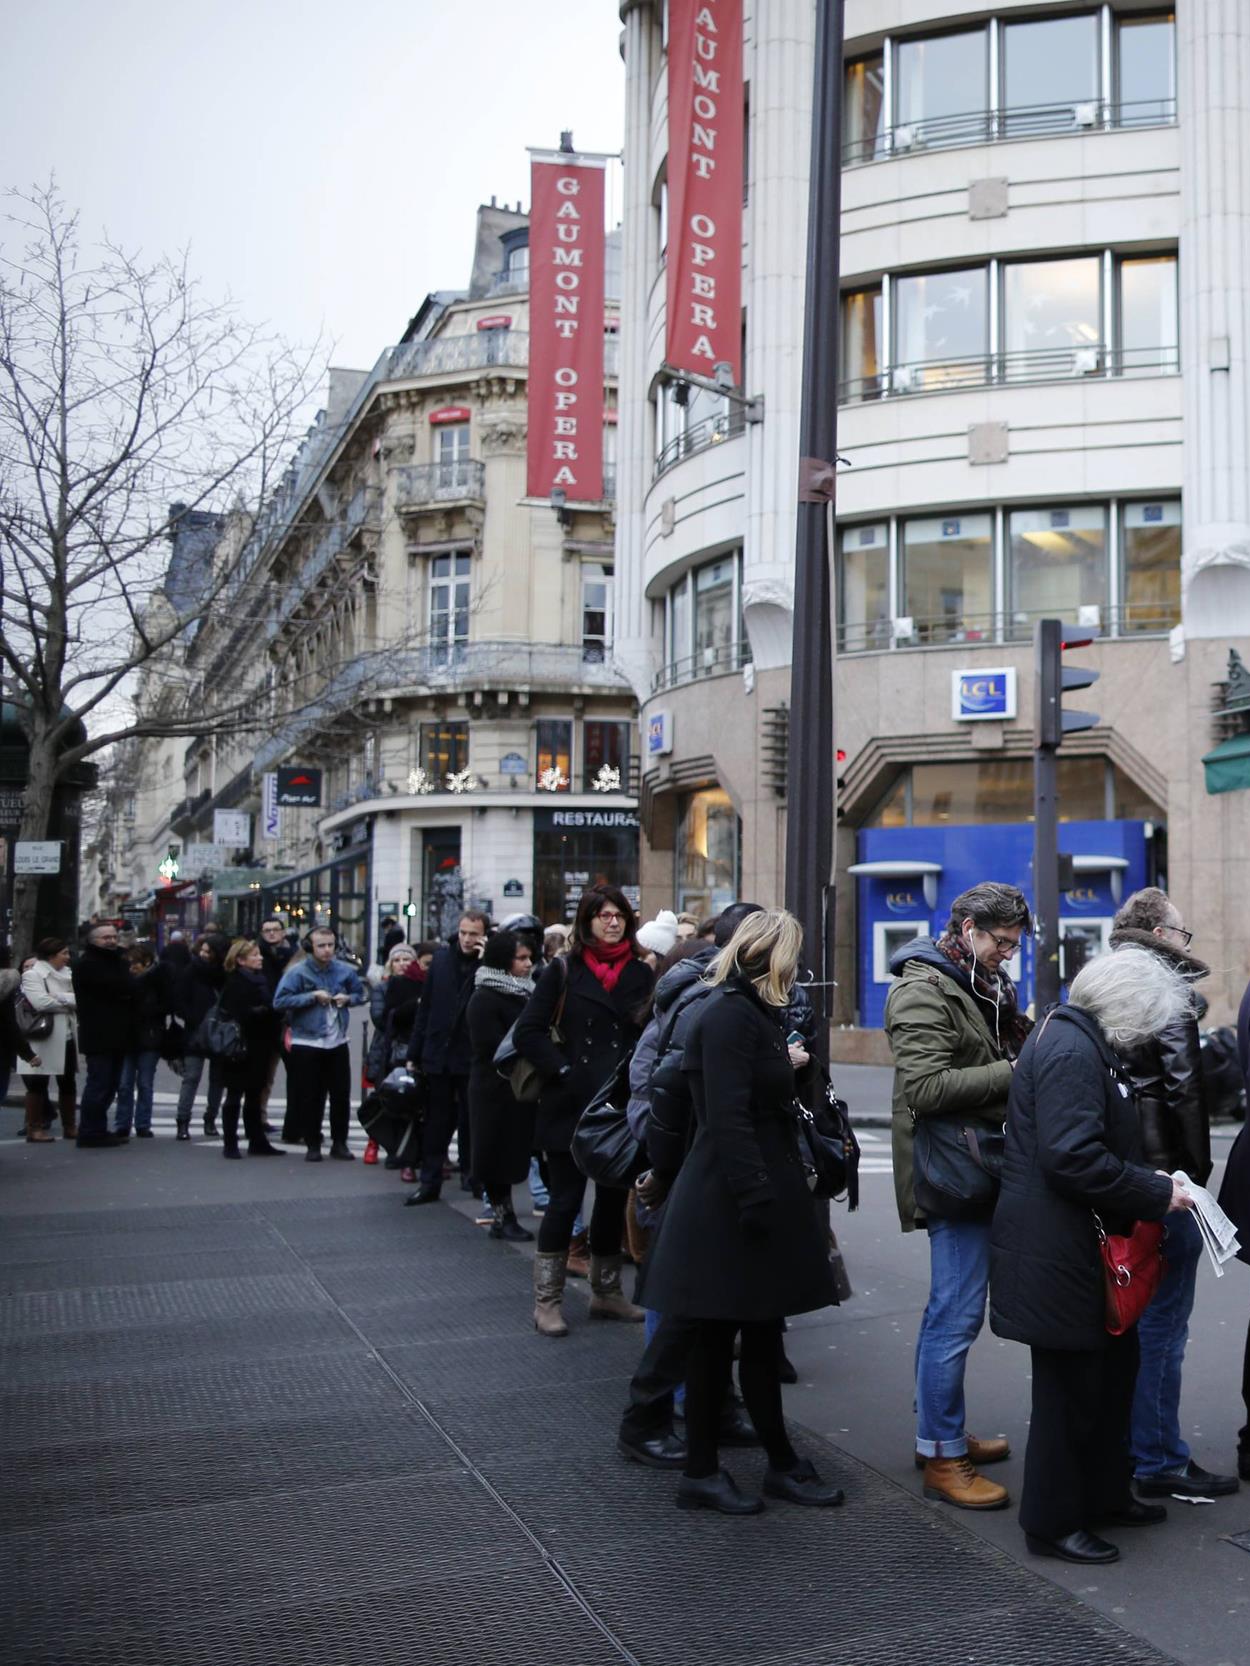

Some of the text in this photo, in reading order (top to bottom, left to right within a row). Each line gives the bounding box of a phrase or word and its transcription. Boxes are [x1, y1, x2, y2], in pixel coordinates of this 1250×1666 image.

[552, 177, 583, 487] GAUMONT OPERA
[690, 0, 721, 361] AUMONT OPERA
[553, 811, 641, 827] RESTAURA
